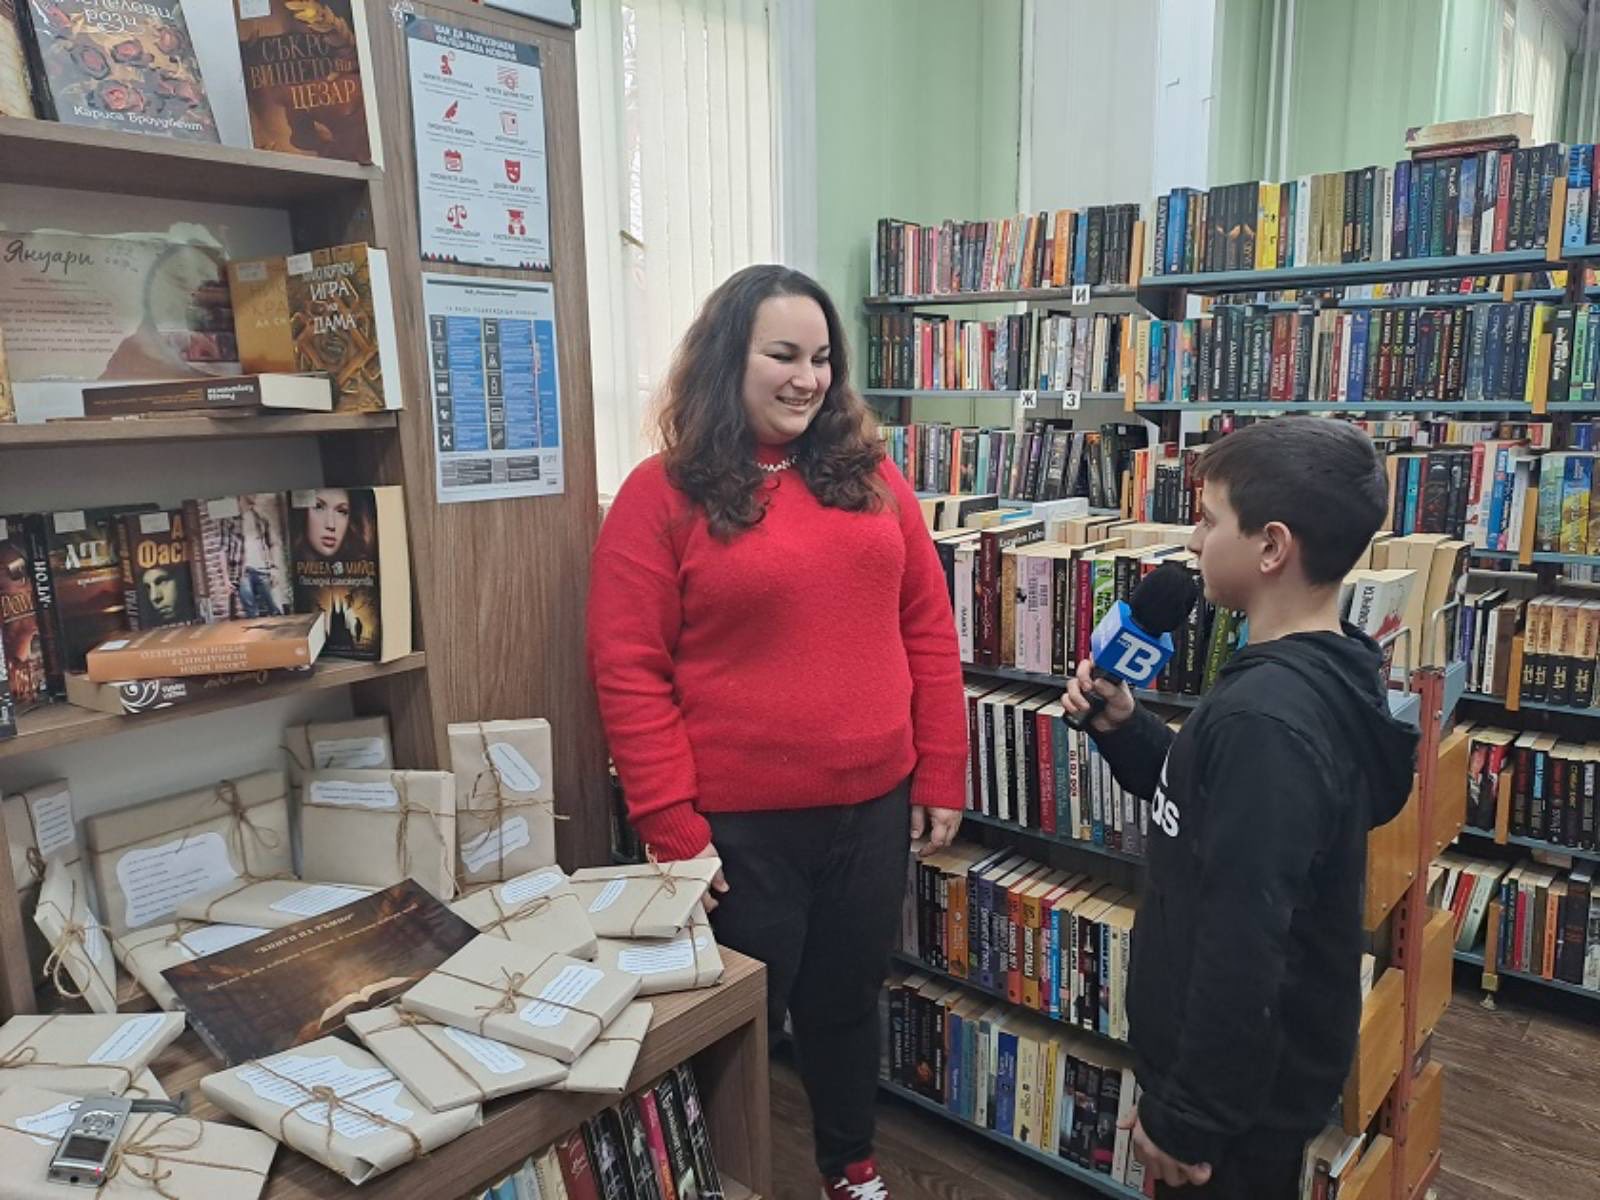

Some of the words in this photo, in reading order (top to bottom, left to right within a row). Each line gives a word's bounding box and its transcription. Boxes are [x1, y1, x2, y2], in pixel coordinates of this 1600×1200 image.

[291, 80, 357, 112] ЦЕЗАР
[3, 239, 95, 275] Януари
[310, 281, 350, 301] ИГРА
[1075, 289, 1088, 303] И
[313, 313, 357, 334] ДАМА
[1022, 392, 1035, 405] Ж
